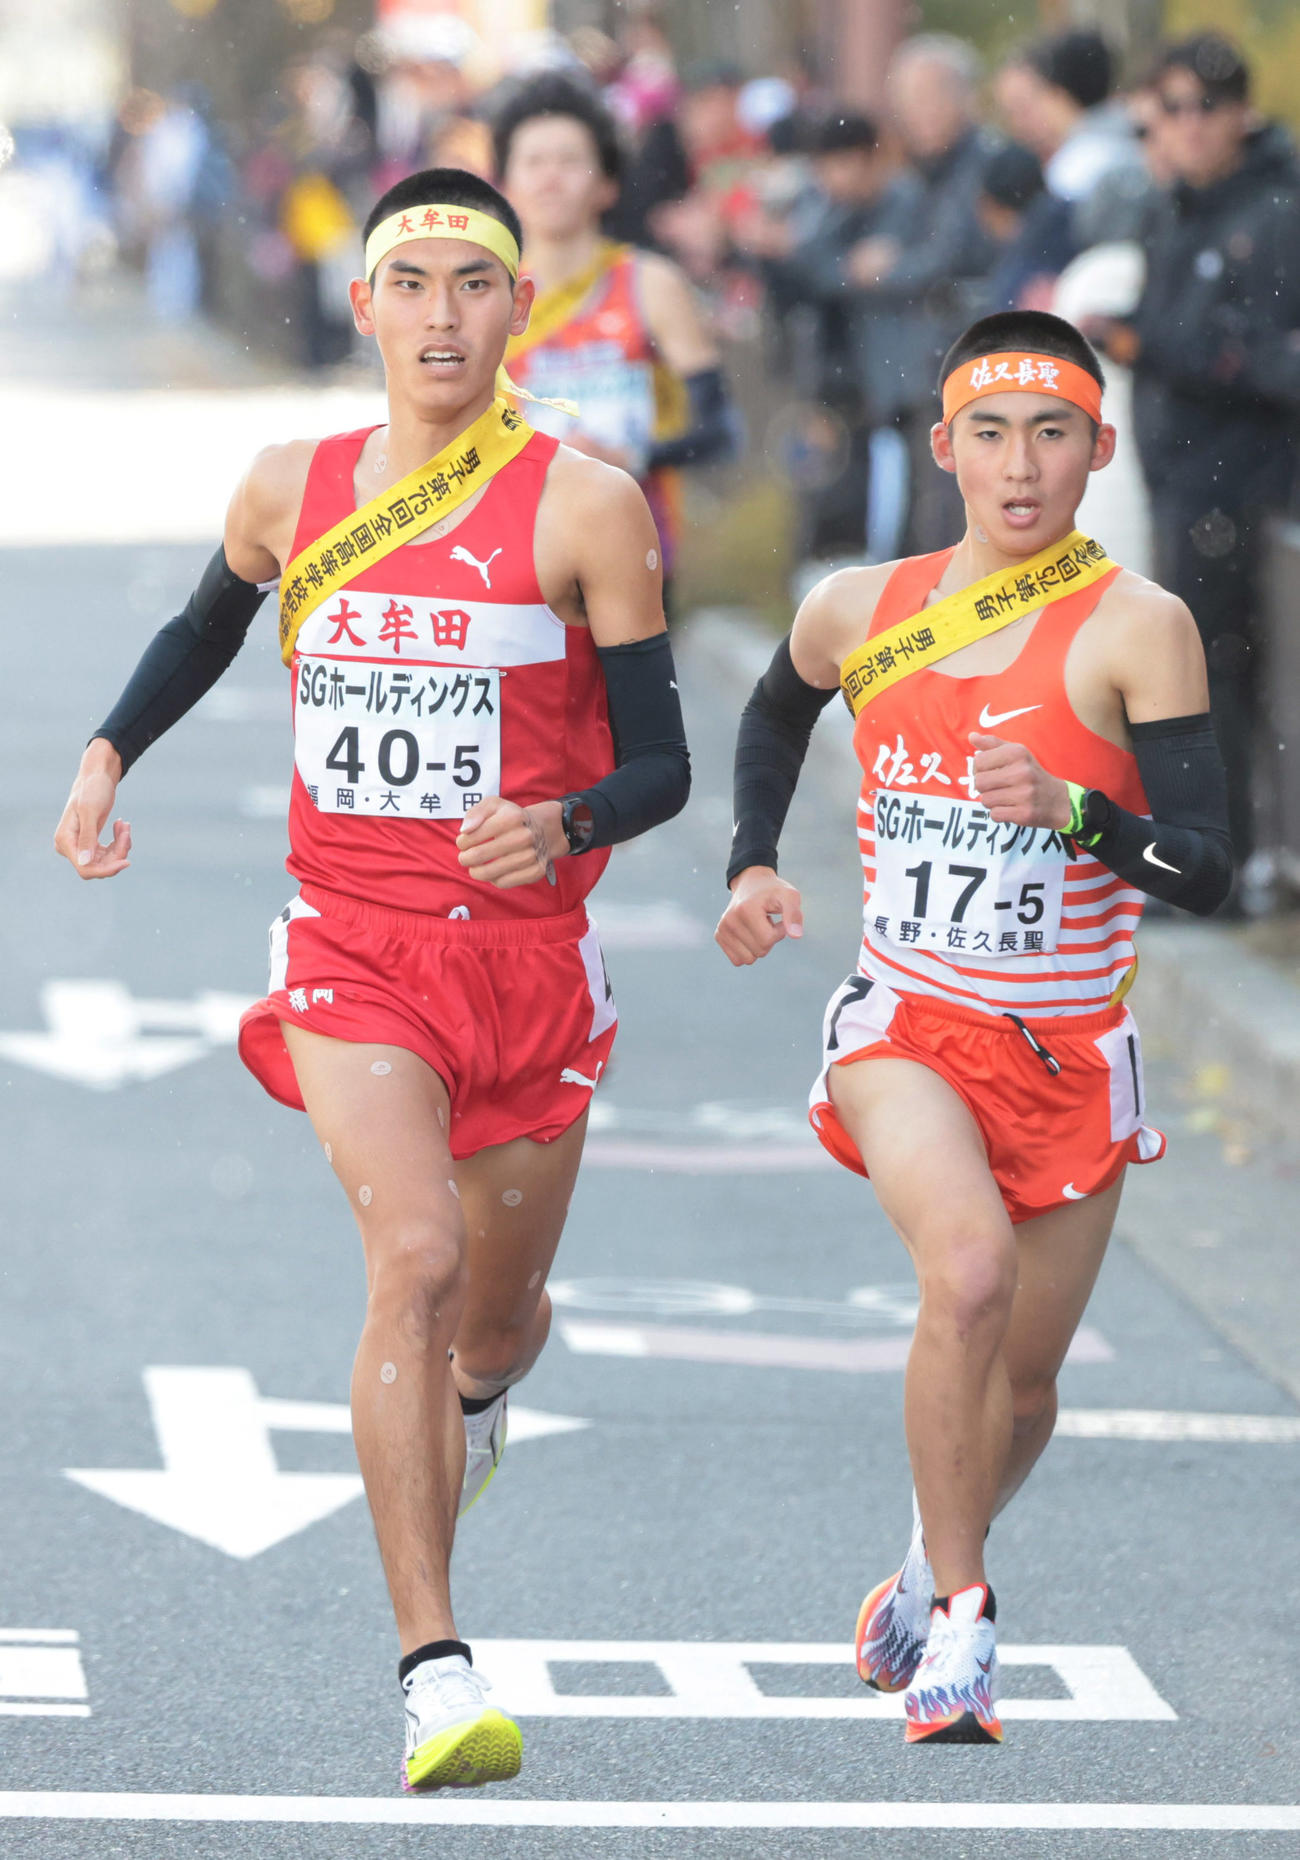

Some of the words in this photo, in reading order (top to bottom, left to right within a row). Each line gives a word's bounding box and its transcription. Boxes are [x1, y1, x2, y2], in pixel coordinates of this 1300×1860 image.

[396, 208, 469, 238] 大牟田
[969, 358, 1060, 391] 佐久長聖
[327, 598, 472, 654] 大牟田
[300, 663, 494, 717] SGホールディングス
[325, 726, 482, 788] 40-5
[905, 860, 1046, 925] 17-5
